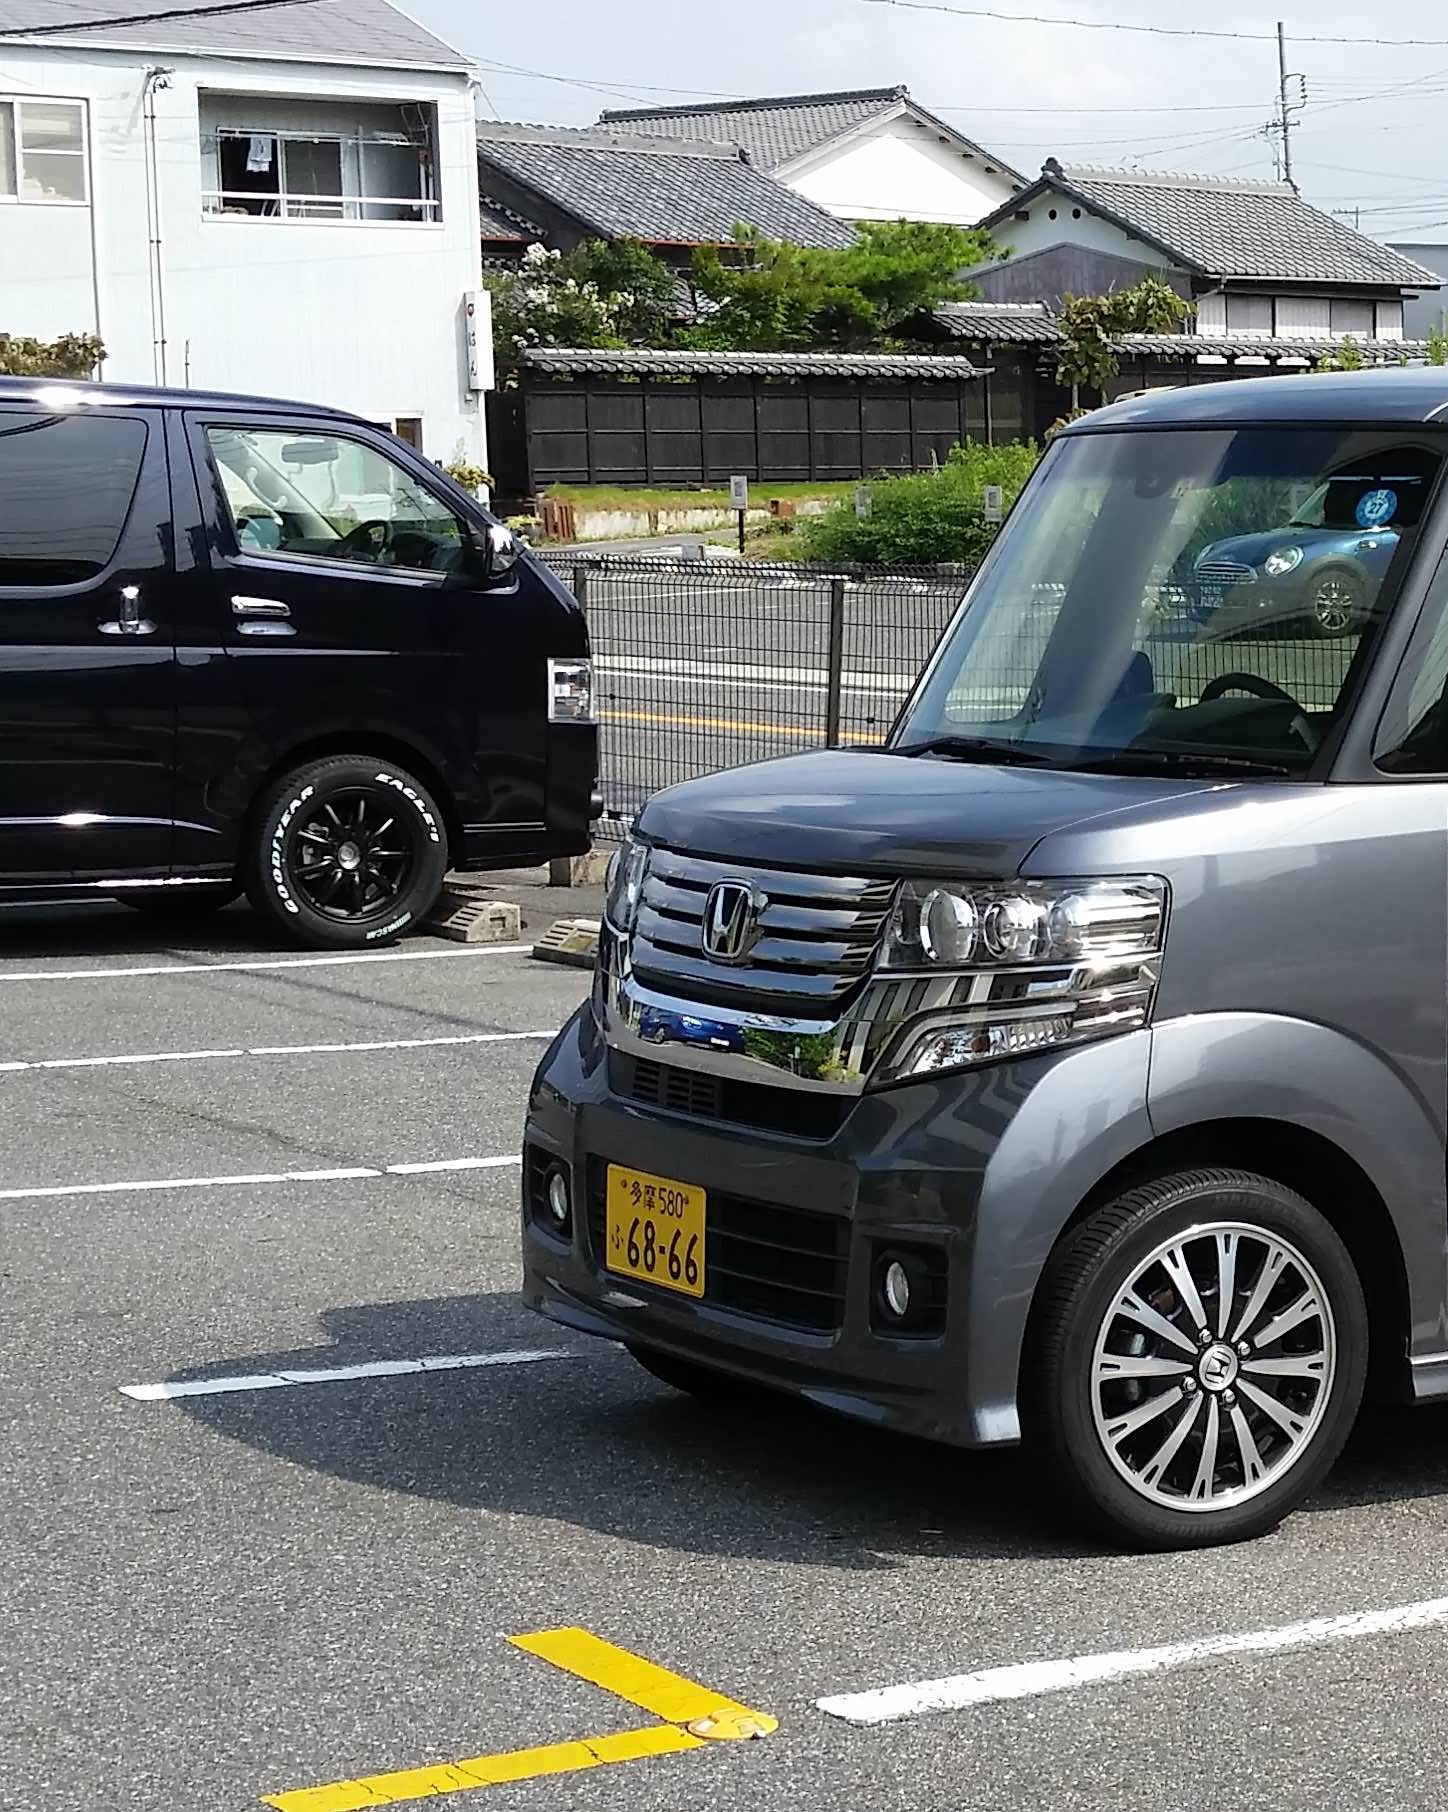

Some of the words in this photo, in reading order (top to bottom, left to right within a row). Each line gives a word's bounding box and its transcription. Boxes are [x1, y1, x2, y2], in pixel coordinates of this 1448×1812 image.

[1367, 502, 1384, 515] 27
[375, 773, 436, 826] EAGLE
[271, 785, 315, 913] GOODYEAR
[627, 1217, 698, 1286] 68-66
